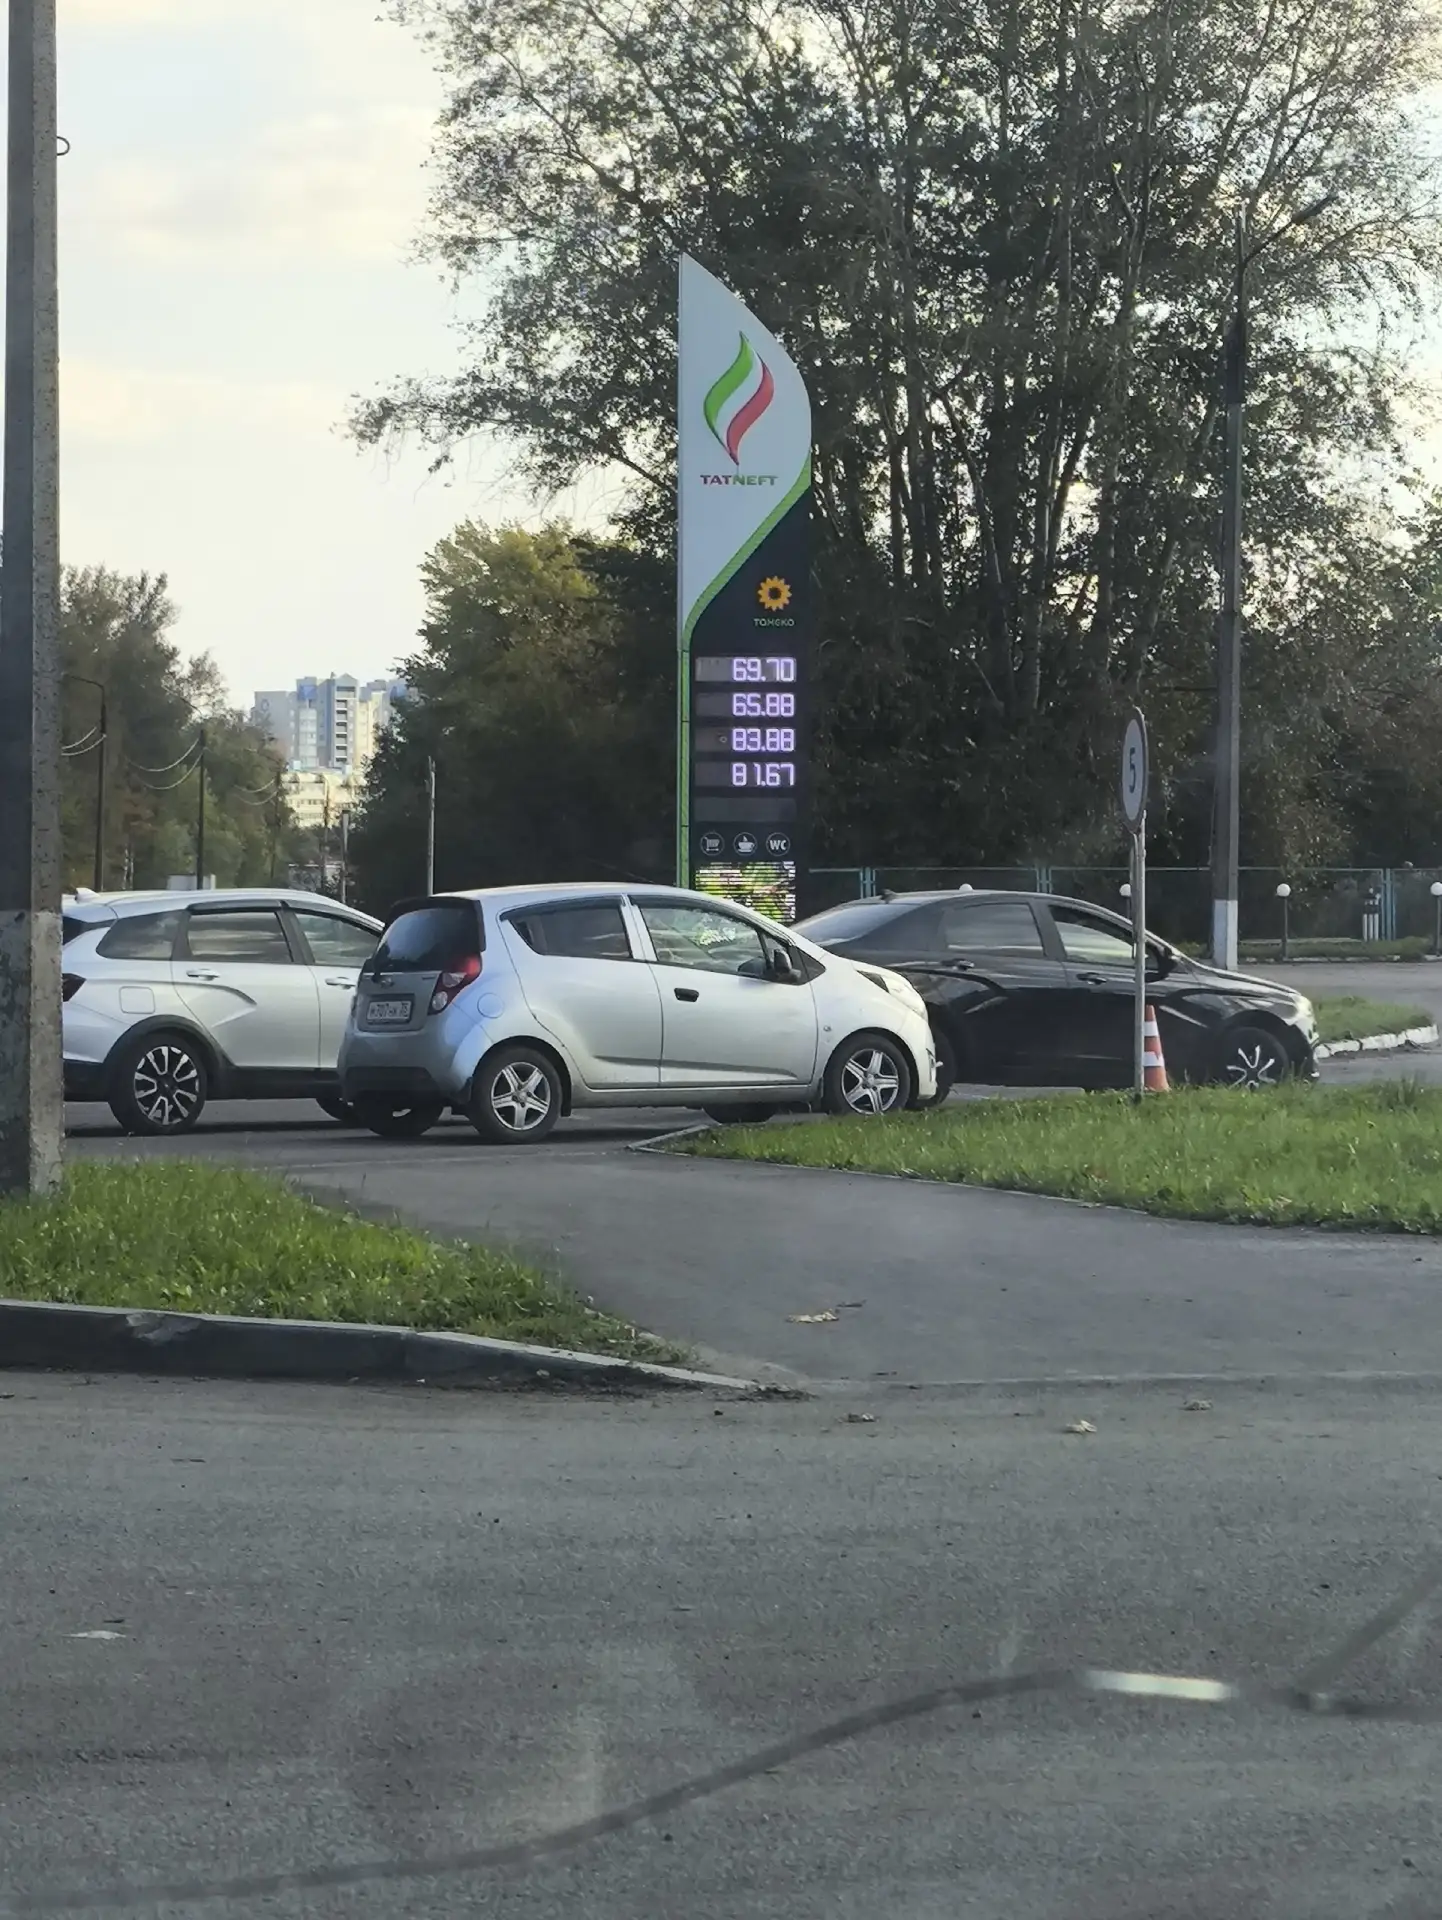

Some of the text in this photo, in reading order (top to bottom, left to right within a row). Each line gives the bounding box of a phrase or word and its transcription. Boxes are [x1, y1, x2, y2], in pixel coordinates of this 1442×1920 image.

[700, 474, 779, 486] TATNEFT
[732, 658, 795, 682] 69.70
[732, 693, 795, 717] 65.88
[732, 728, 795, 751] 83.88
[732, 762, 795, 786] 81.67
[1128, 747, 1136, 794] 5
[769, 840, 787, 851] WC
